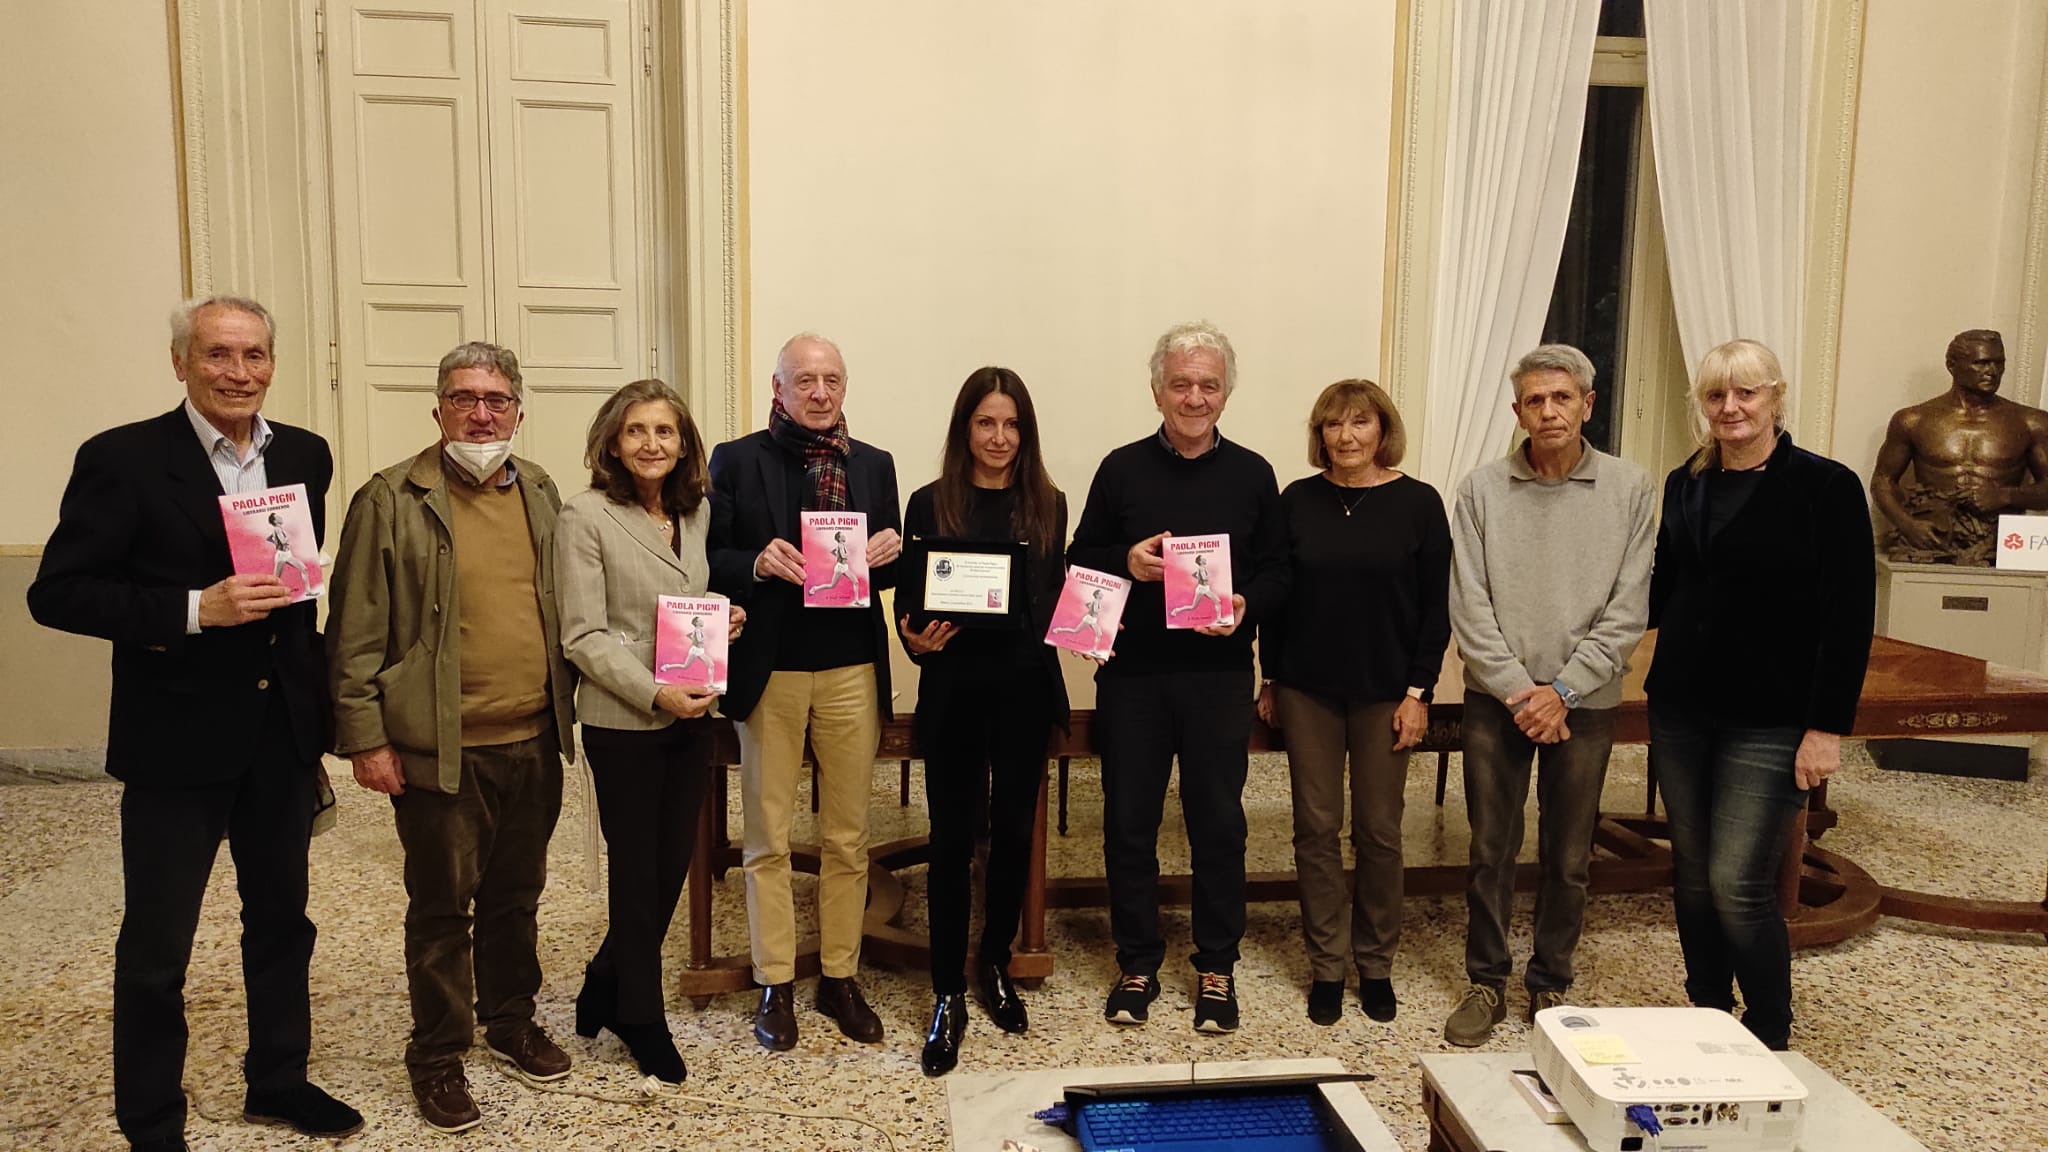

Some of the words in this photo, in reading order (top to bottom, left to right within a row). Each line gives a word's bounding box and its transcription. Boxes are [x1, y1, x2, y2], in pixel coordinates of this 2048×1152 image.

[232, 496, 267, 510] PAOLA
[269, 492, 296, 505] PIGNI
[809, 517, 836, 526] PAOLA
[838, 517, 859, 526] PIGNI
[1170, 542, 1196, 551] PAOLA
[1198, 540, 1220, 549] PIGNI
[1075, 571, 1099, 584] PAOLA
[1101, 577, 1122, 590] PIGNI
[666, 601, 694, 610] PAOLA
[696, 603, 720, 611] PIGNI
